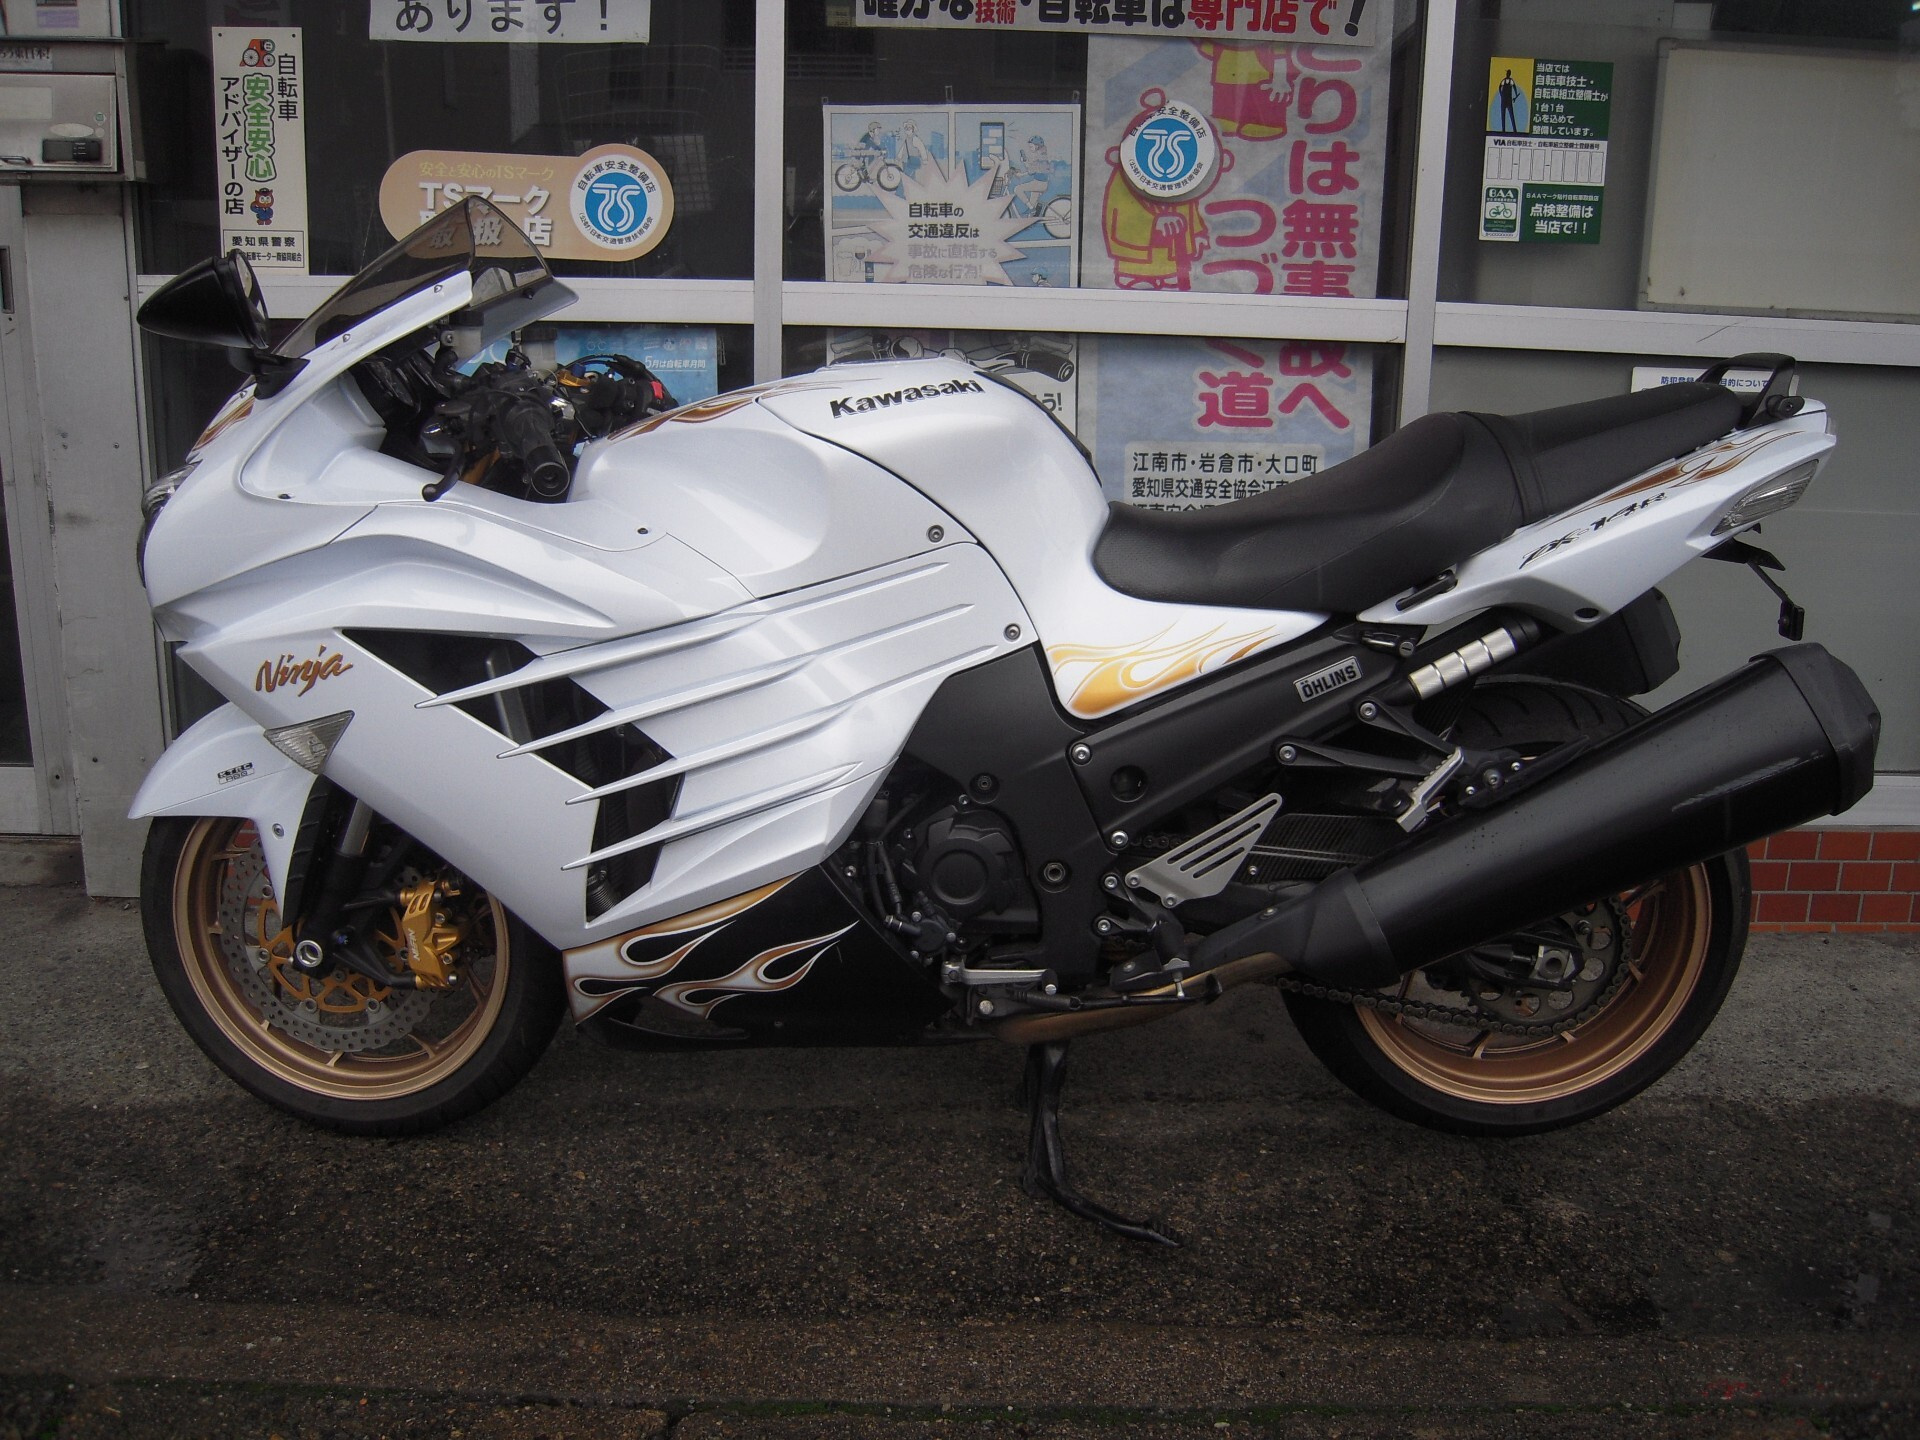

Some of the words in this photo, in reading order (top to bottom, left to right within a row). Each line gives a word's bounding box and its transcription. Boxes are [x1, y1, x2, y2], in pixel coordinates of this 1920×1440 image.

[396, 0, 608, 34] あります！
[1536, 64, 1570, 73] 当店では
[278, 54, 298, 121] 自転車
[1534, 88, 1608, 102] 自転車組立整備士が
[1533, 114, 1574, 124] 心を込めて
[245, 76, 274, 180] 安全安心
[1532, 126, 1594, 137] 整備しています。
[220, 77, 244, 215] アドバイザーの店
[419, 161, 554, 181] 安全と安心のTSマーク
[577, 160, 656, 193] 自転車安全整備店
[419, 182, 550, 220] TSマーク
[1489, 188, 1514, 198] BAA
[908, 202, 964, 218] 自転車の
[1530, 203, 1594, 219] 点検整備は
[908, 223, 979, 239] 交通違反は
[1535, 220, 1588, 234] 当店で！！
[232, 236, 296, 247] 愛知県警察
[908, 243, 998, 259] 事故に直結する
[908, 264, 982, 279] 危険な行為!
[645, 355, 706, 369] 5月は自転車月間
[829, 379, 986, 419] Kawasaki
[1133, 452, 1317, 475] 江南市・岩倉市・大口町
[255, 644, 353, 697] Ninja
[1301, 665, 1356, 698] ÖHLINS
